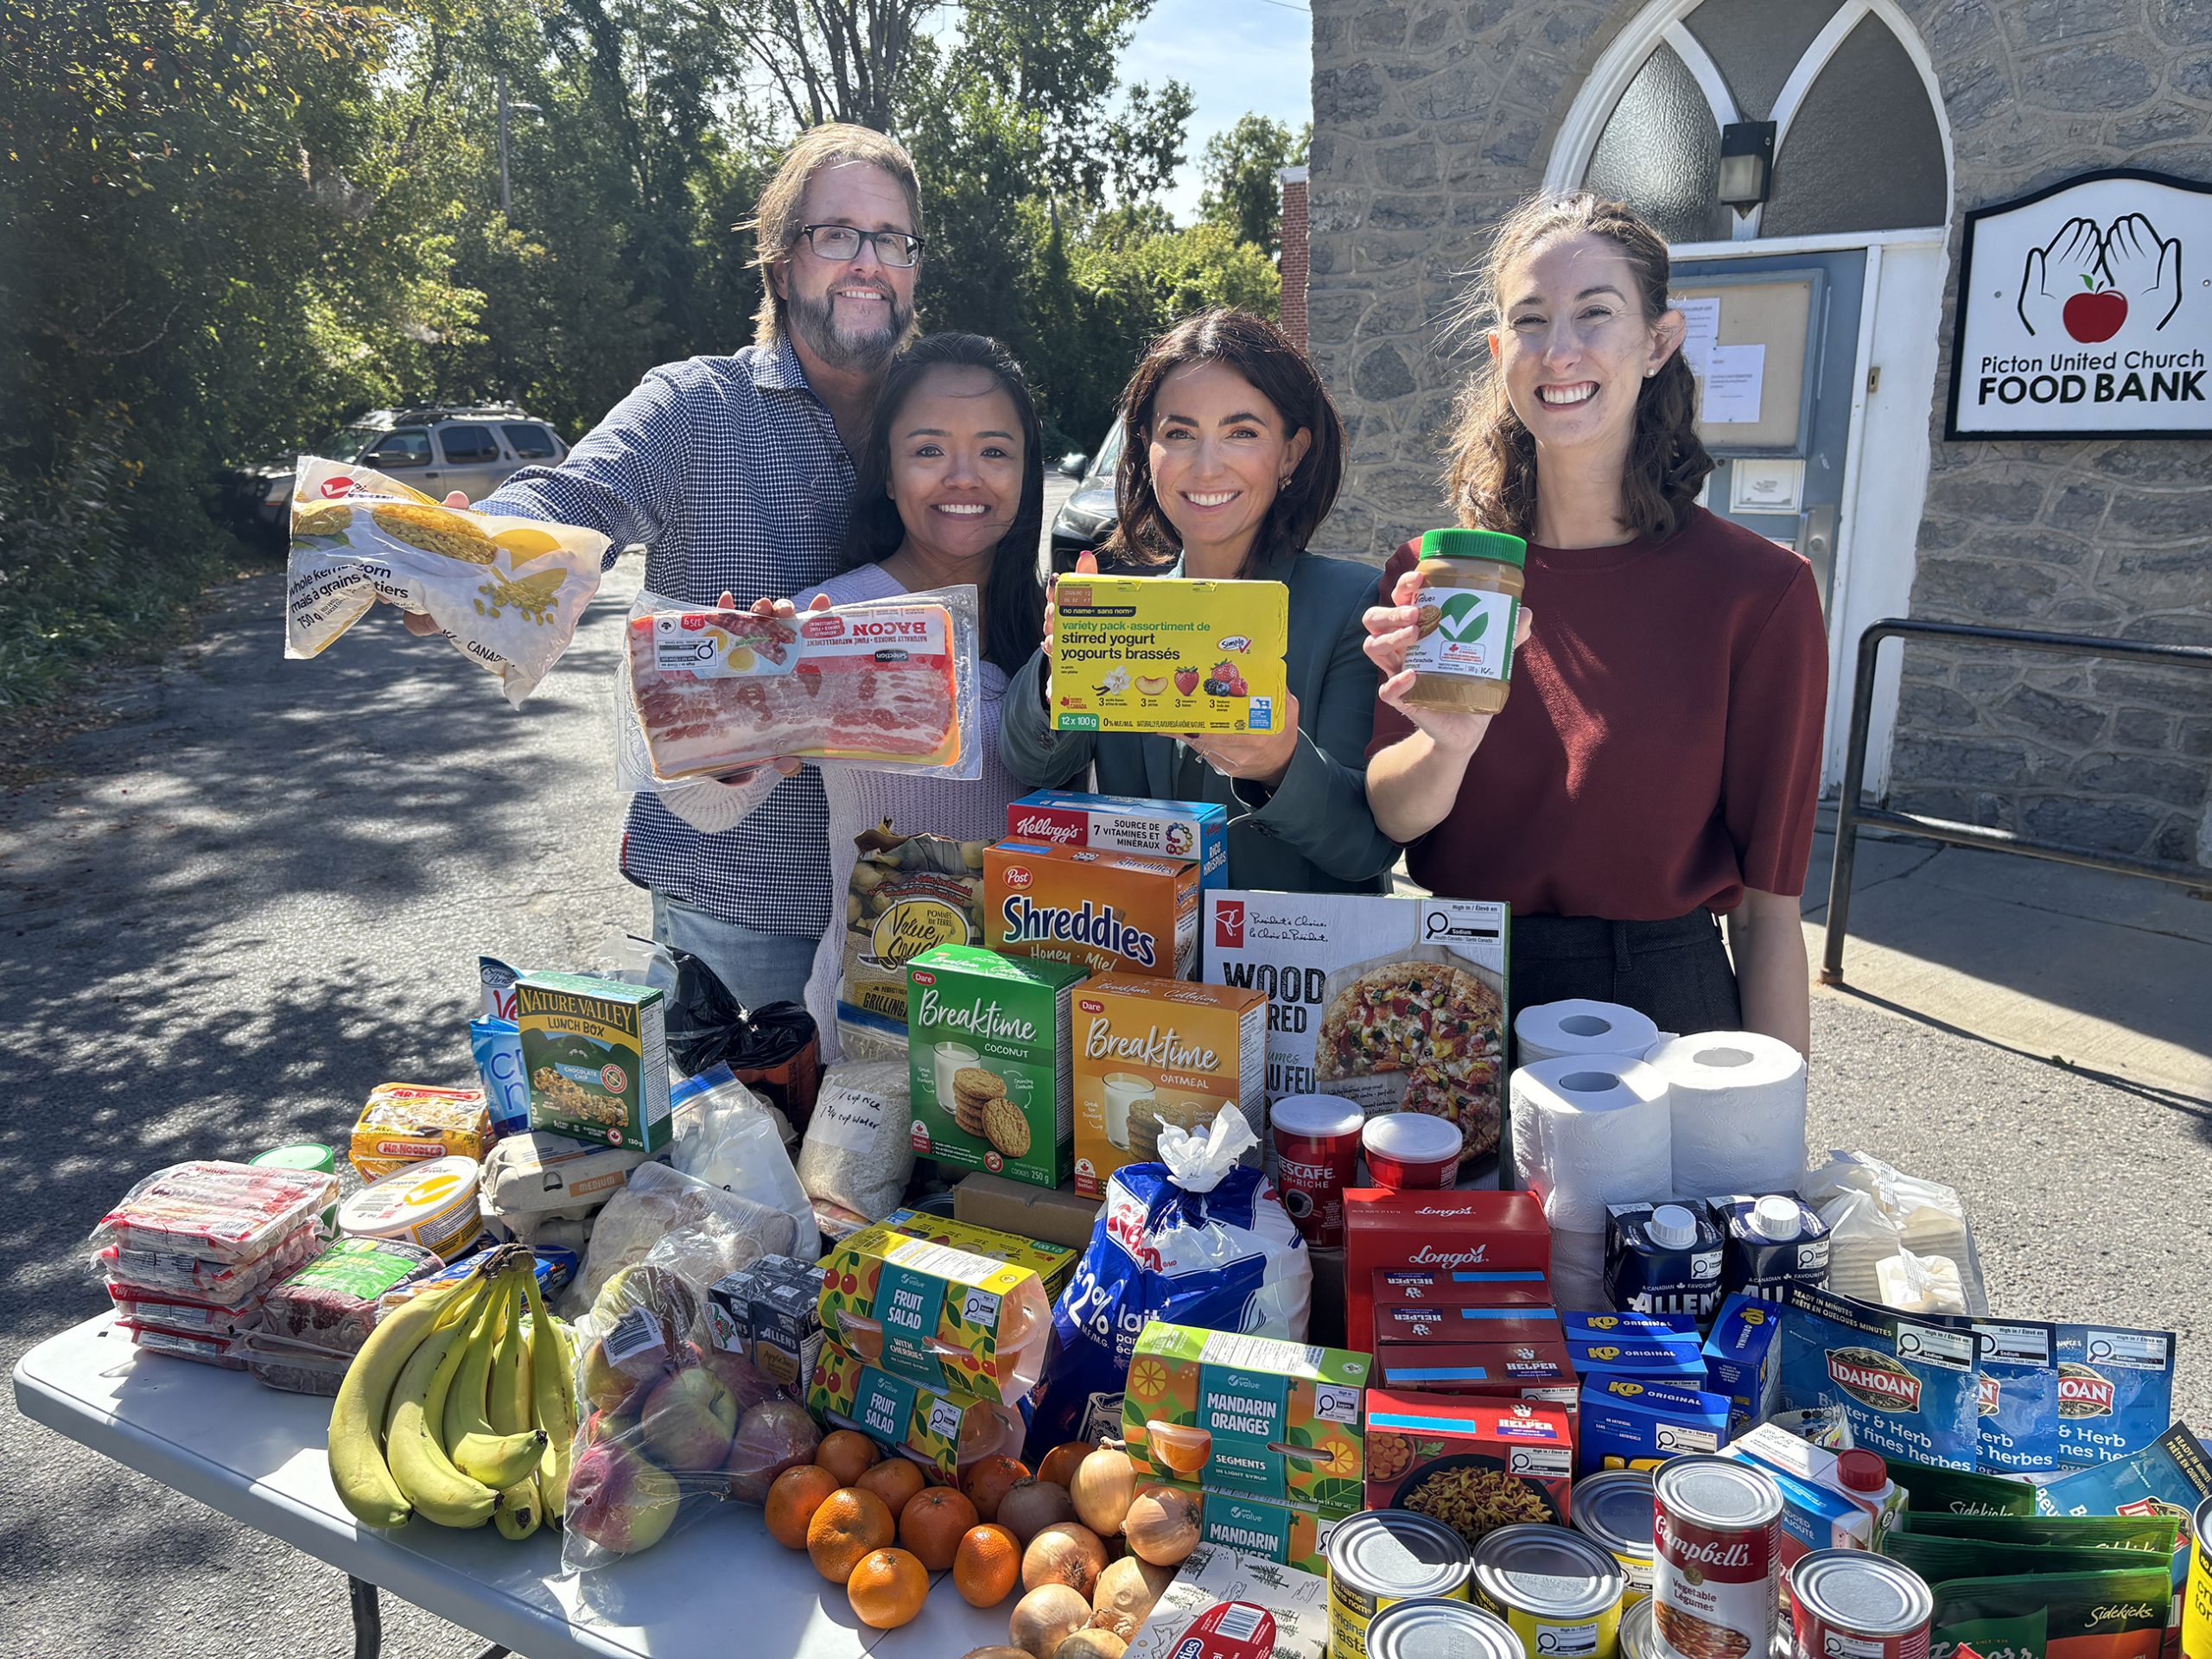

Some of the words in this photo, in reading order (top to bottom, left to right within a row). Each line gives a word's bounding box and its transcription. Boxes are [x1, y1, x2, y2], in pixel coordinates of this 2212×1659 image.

[1981, 355, 2043, 373] Picton
[2050, 351, 2116, 371] United
[2124, 349, 2204, 369] Church
[1979, 374, 2086, 404] FOOD
[2094, 370, 2208, 403] BANK
[313, 588, 321, 601] à
[320, 574, 361, 595] grains
[297, 613, 315, 630] 750
[853, 622, 926, 636] BACON
[1062, 620, 1098, 632] variety
[1100, 621, 1126, 632] pack
[1129, 621, 1195, 632] assortiment
[1196, 622, 1211, 632] de
[807, 638, 853, 647] NATURELLEMENT
[1062, 632, 1107, 644] stirred
[1109, 633, 1155, 646] yogurt
[876, 652, 907, 660] Selection
[1061, 647, 1122, 661] yogourts
[1126, 647, 1180, 660] brassés
[1098, 697, 1104, 707] 3
[1141, 698, 1147, 708] 3
[1175, 698, 1181, 708] 3
[1210, 699, 1216, 709] 3
[1061, 716, 1071, 725] 12
[1077, 716, 1090, 726] 100
[1090, 718, 1096, 728] g
[1017, 816, 1080, 843] Kellogg's
[1093, 824, 1101, 836] 7
[1103, 827, 1147, 839] VITAMINES
[1149, 830, 1160, 840] ET
[1114, 819, 1146, 830] SOURCE
[1149, 822, 1160, 831] DE
[1117, 837, 1160, 850] MINÉRAUX
[1118, 858, 1175, 875] Shreddies
[1007, 868, 1029, 884] Post
[937, 918, 952, 926] TERRE
[1249, 912, 1292, 926] President's
[1002, 894, 1156, 968] Shreddies
[1031, 944, 1071, 964] Honey
[1084, 952, 1118, 973] Miel
[915, 973, 932, 983] Dare
[1223, 962, 1326, 1004] WOOD
[519, 988, 577, 1014] NATURE
[578, 998, 632, 1033] VALLEY
[918, 988, 1038, 1042] Breaktime
[1082, 1001, 1101, 1012] Dare
[547, 1016, 581, 1032] LUNCH
[583, 1021, 605, 1038] BOX
[984, 1042, 1029, 1059] COCONUT
[1084, 1017, 1220, 1071] Breaktime
[563, 1066, 597, 1077] CHOCOLATE
[1285, 1065, 1316, 1095] FEU
[1160, 1072, 1209, 1090] OATMEAL
[531, 1103, 537, 1116] 5
[862, 1097, 880, 1111] rice
[399, 1144, 443, 1156] NOODLES
[1031, 1171, 1044, 1181] 250
[1044, 1175, 1050, 1184] g
[1296, 1179, 1330, 1189] RICHE
[1414, 1206, 1474, 1217] Longo's
[1408, 1243, 1486, 1270] Longo's
[1688, 1281, 1718, 1290] FAVOURITE
[1753, 1275, 1782, 1284] CANADIAN
[1794, 1270, 1826, 1280] FAVOURITE
[893, 1288, 924, 1312] FRUIT
[1068, 1272, 1114, 1335] 2%
[1629, 1285, 1722, 1315] ALLEN'S
[1793, 1289, 1815, 1304] READY
[1815, 1296, 1824, 1307] IN
[1824, 1300, 1853, 1318] MINUTES
[887, 1307, 922, 1330] SALAD
[1117, 1304, 1160, 1333] lait
[1586, 1315, 1619, 1331] KD
[1623, 1319, 1673, 1328] ORIGINAL
[1739, 1306, 1765, 1325] KD
[1791, 1298, 1811, 1312] PRÊTE
[1812, 1302, 1821, 1314] EN
[1822, 1308, 1859, 1328] QUELQUES
[1859, 1322, 1892, 1338] MINUTES
[893, 1338, 913, 1350] WITH
[1735, 1325, 1753, 1349] ORIGINAL
[890, 1344, 925, 1361] CHERRIES
[1586, 1346, 1621, 1361] KD
[1624, 1349, 1676, 1358] ORIGINAL
[1923, 1351, 1944, 1360] Sodium
[1238, 1379, 1261, 1389] value
[1832, 1360, 1916, 1401] IDAHOAN
[1608, 1382, 1645, 1398] KD
[1647, 1390, 1701, 1406] ORIGINAL
[870, 1392, 897, 1416] FRUIT
[1207, 1393, 1277, 1419] MANDARIN
[865, 1408, 894, 1434] SALAD
[1211, 1414, 1270, 1436] ORANGES
[1498, 1419, 1554, 1431] HELPER
[1873, 1415, 1885, 1429] &
[1889, 1421, 1932, 1449] Herb
[2058, 1424, 2073, 1438] &
[2076, 1427, 2126, 1447] Herb
[1863, 1427, 1904, 1454] fines
[1907, 1444, 1971, 1471] herbes
[1989, 1446, 2053, 1466] herbes
[2166, 1440, 2185, 1462] PRÊTE
[2180, 1458, 2190, 1469] EN
[2174, 1434, 2194, 1457] READY
[2192, 1456, 2202, 1465] IN
[1216, 1453, 1266, 1471] SEGMENTS
[1224, 1470, 1244, 1478] LIGHT
[1246, 1473, 1268, 1482] SYRUP
[1240, 1512, 1262, 1522] value
[1782, 1507, 1810, 1529] ADDED
[1783, 1516, 1815, 1540] AJOUTÉ
[1210, 1523, 1279, 1552] MANDARIN
[1655, 1513, 1751, 1567] Campbell's
[1340, 1584, 1363, 1604] name
[1672, 1577, 1718, 1603] Vegetable
[1348, 1599, 1369, 1615] nom
[1674, 1589, 1715, 1612] Légumes
[2084, 1603, 2152, 1628] Sidekicks
